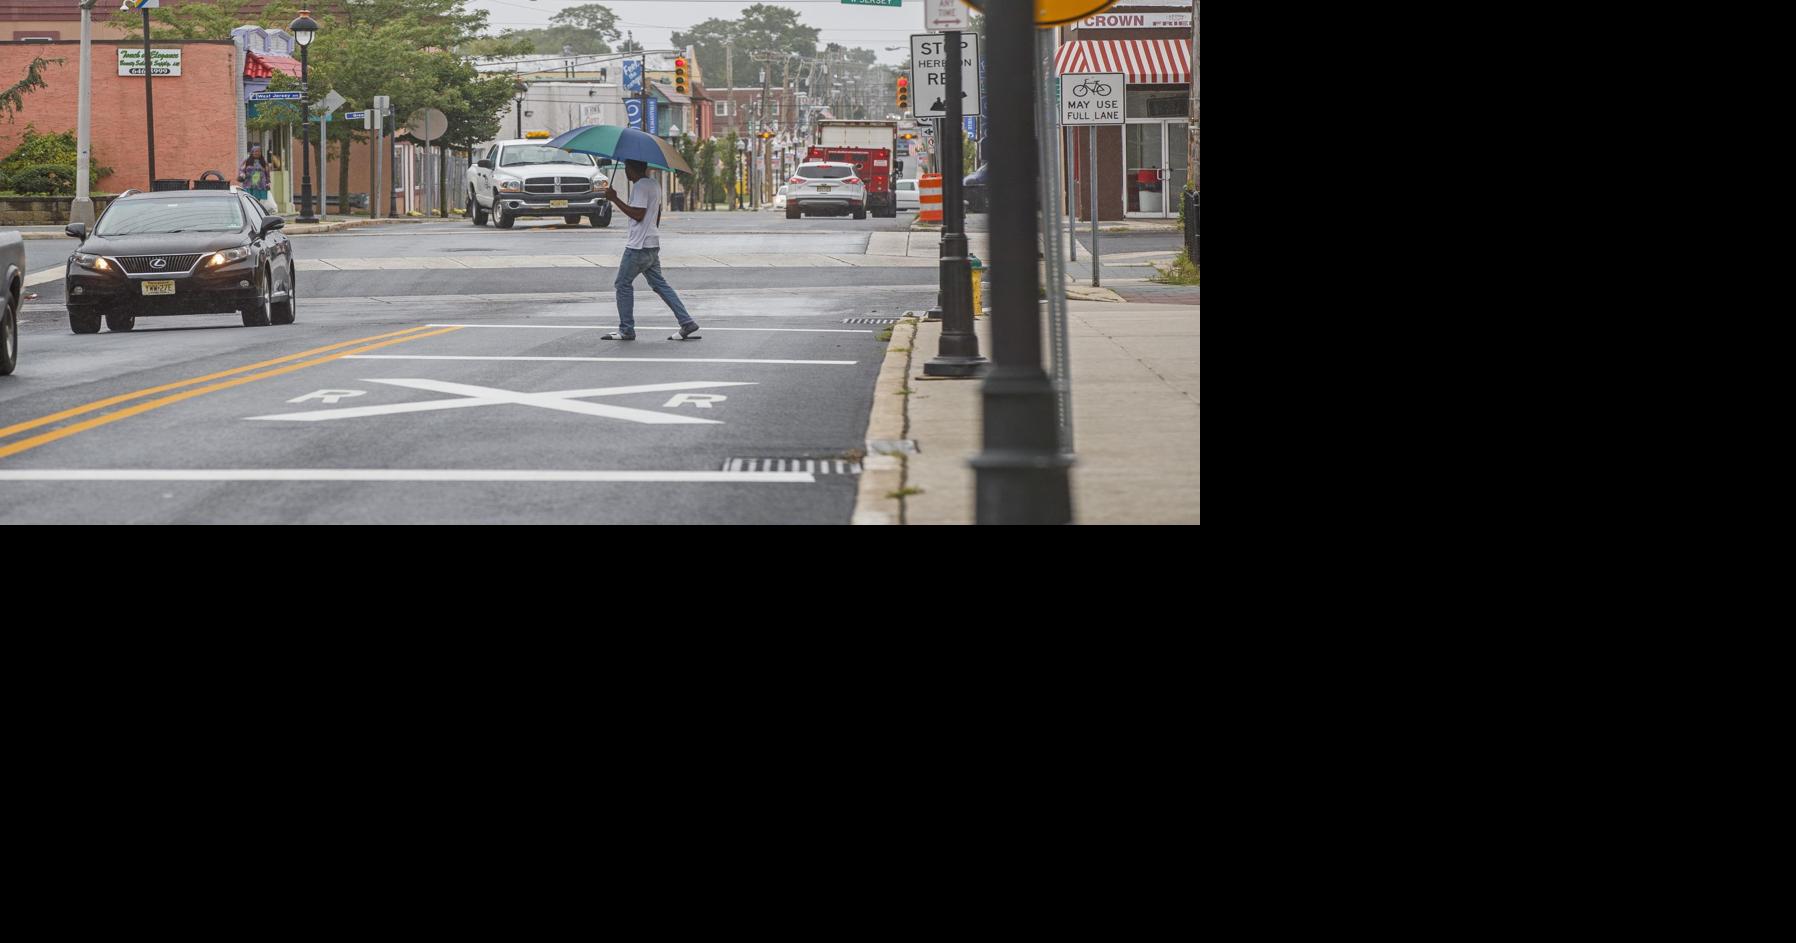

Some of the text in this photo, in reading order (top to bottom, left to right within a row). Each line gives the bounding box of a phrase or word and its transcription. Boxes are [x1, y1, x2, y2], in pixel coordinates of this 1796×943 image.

[1084, 15, 1144, 27] CROWN
[921, 42, 968, 55] STP
[928, 73, 947, 85] RE
[1068, 101, 1118, 109] MAY USE
[1067, 112, 1119, 120] FULL LANE
